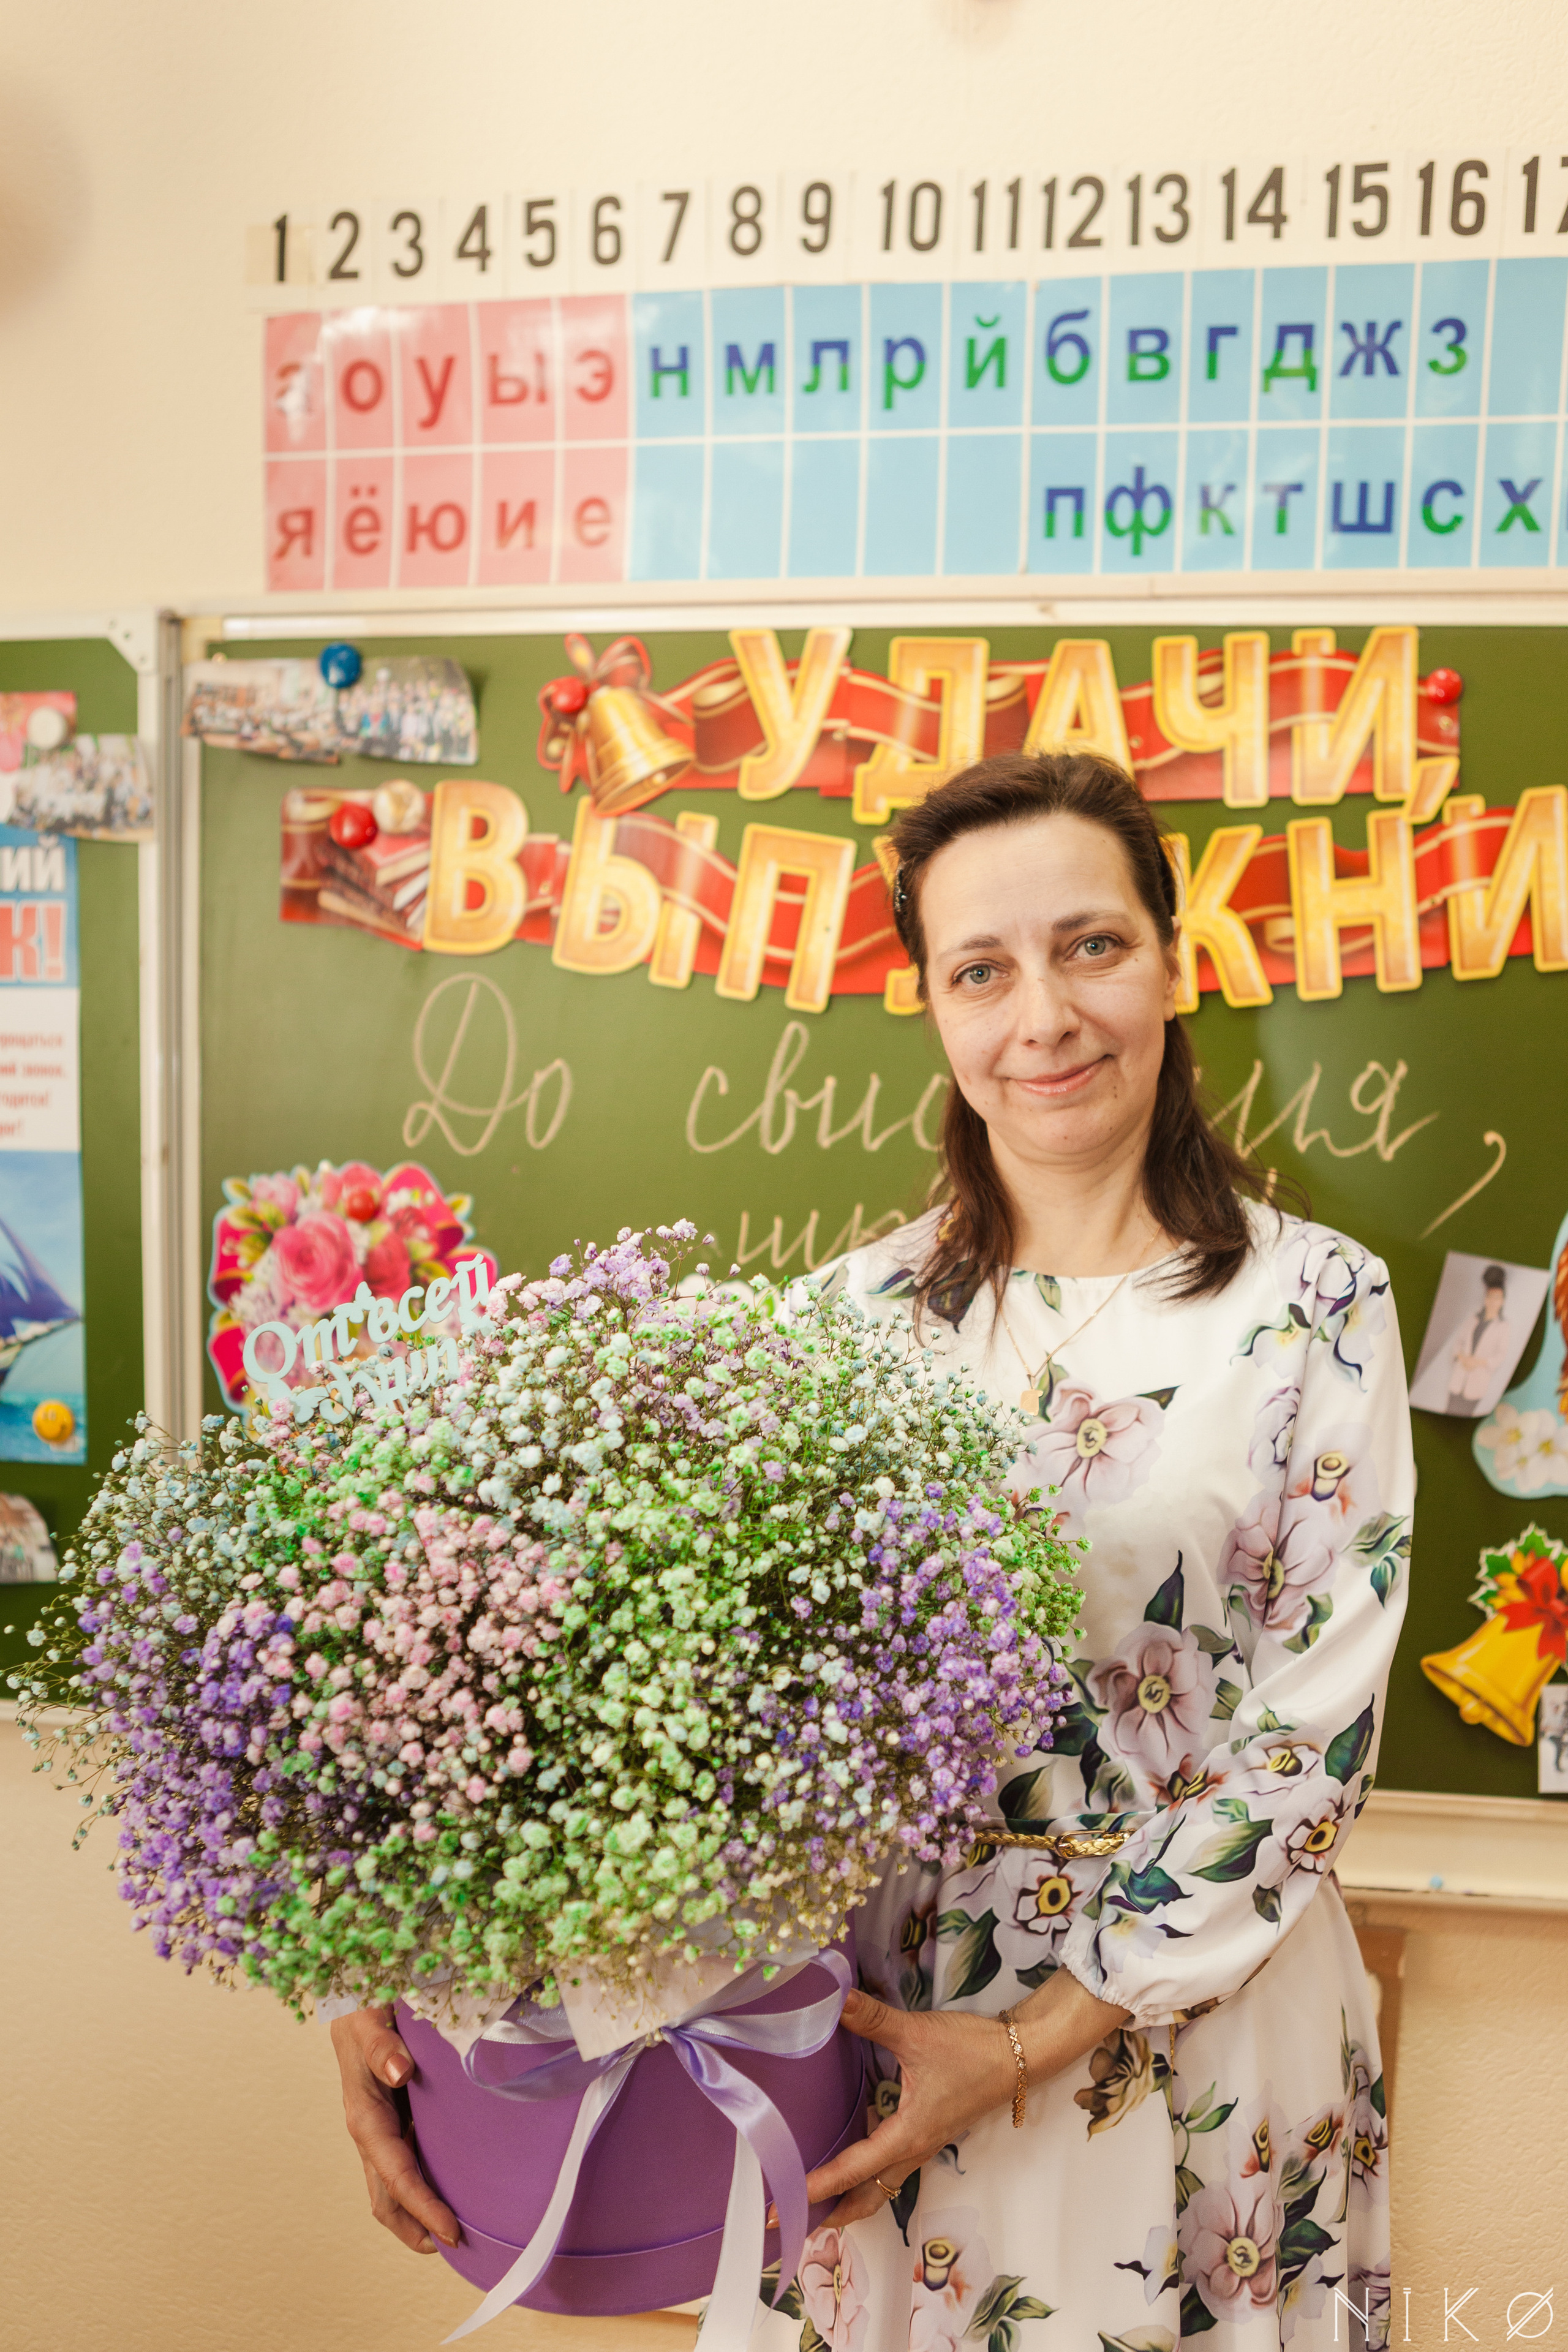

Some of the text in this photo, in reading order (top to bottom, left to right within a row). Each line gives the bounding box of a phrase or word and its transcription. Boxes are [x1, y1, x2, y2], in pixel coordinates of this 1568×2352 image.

[273, 215, 287, 282] 1
[328, 211, 360, 280] 2
[391, 211, 424, 278] 3
[456, 205, 491, 272] 4
[526, 199, 556, 267] 5
[593, 196, 621, 265] 6
[662, 191, 690, 262] 7
[729, 186, 762, 256] 8
[802, 182, 832, 253] 9
[883, 181, 942, 252] 10
[973, 178, 1020, 252] 11
[1043, 176, 1105, 249] 12
[1128, 173, 1189, 246] 13
[1222, 167, 1287, 241] 14
[1325, 162, 1389, 238] 15
[1419, 160, 1488, 236] 16
[342, 361, 383, 412] о
[417, 356, 454, 429] у
[575, 350, 614, 403] э
[652, 347, 688, 398] н
[727, 343, 774, 394] м
[802, 341, 849, 393] л
[884, 337, 925, 409] р
[967, 318, 1006, 388] й
[1047, 311, 1090, 385] б
[1128, 329, 1169, 380] в
[1207, 326, 1237, 380] г
[1264, 324, 1317, 392] д
[1341, 321, 1401, 375] ж
[1428, 318, 1467, 375] з
[276, 508, 314, 559] я
[345, 487, 381, 556] ё
[407, 503, 466, 552] ю
[498, 501, 535, 546] и
[574, 497, 607, 545] е
[1046, 488, 1084, 537] п
[1105, 467, 1172, 556] ф
[1200, 484, 1235, 536] к
[1264, 483, 1303, 535] т
[1333, 482, 1394, 533] ш
[1422, 481, 1463, 535] с
[1497, 480, 1540, 532] х
[729, 625, 1460, 824] УДАЧИ,
[402, 972, 573, 1156] До
